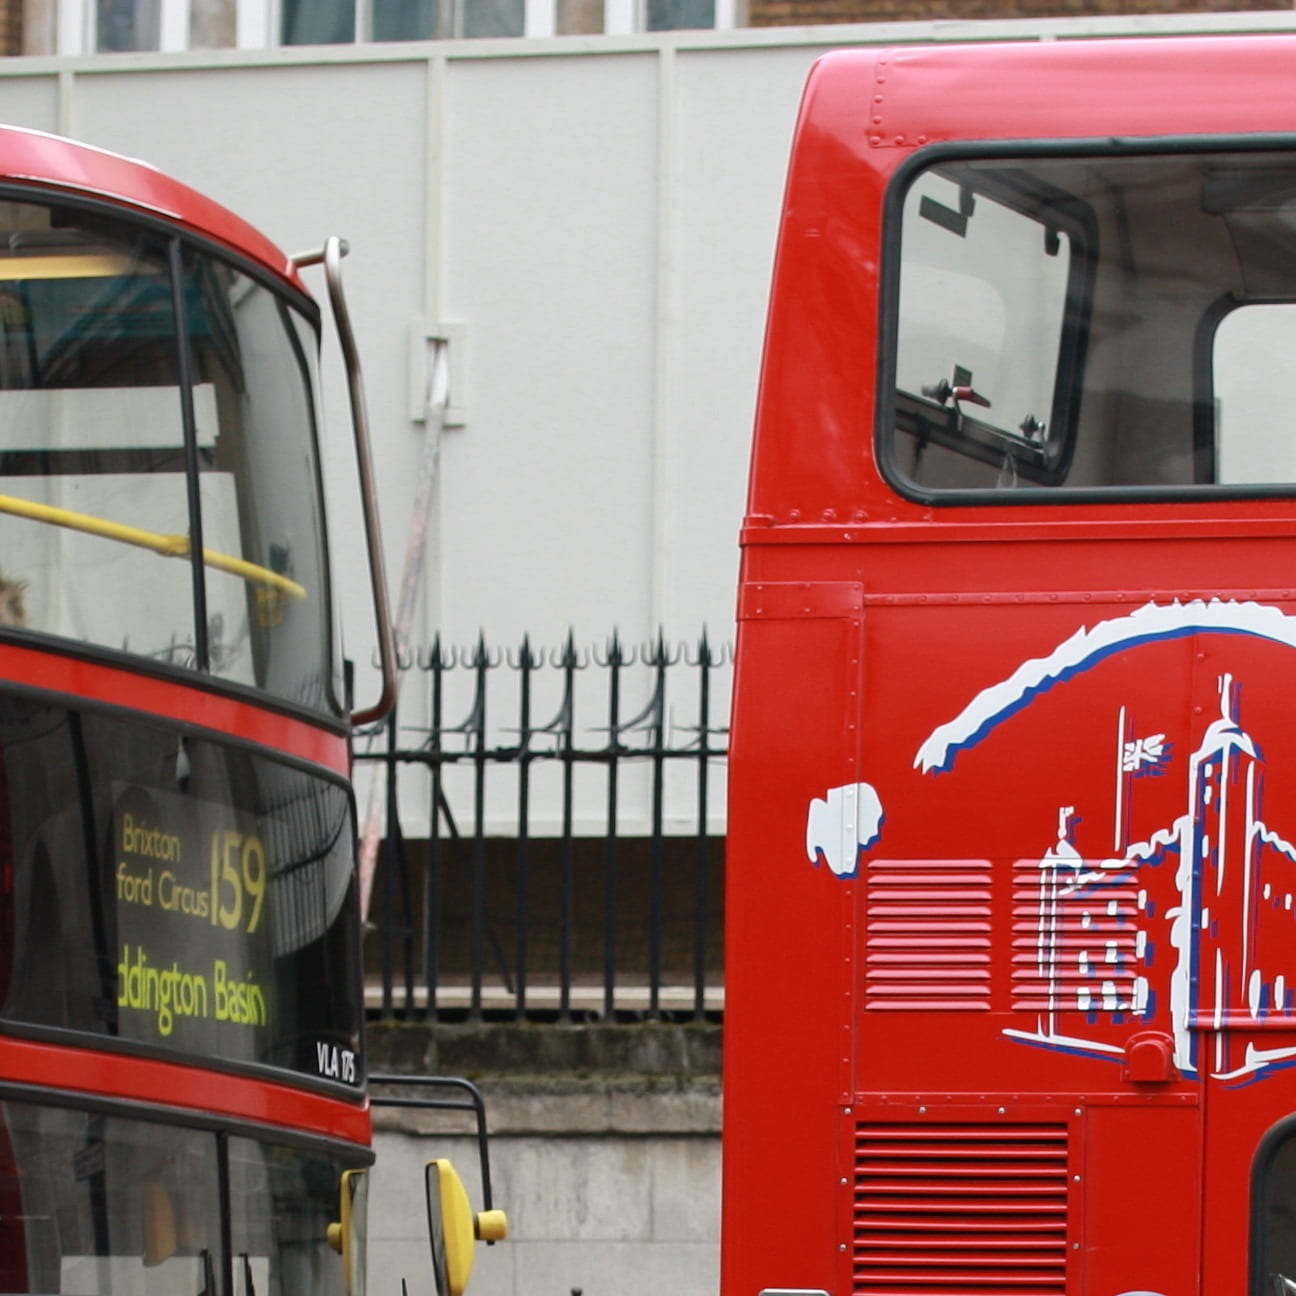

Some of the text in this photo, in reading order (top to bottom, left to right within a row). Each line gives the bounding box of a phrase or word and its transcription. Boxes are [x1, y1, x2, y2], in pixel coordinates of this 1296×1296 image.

[122, 813, 181, 863] Brixton
[158, 870, 209, 919] Circus
[210, 830, 267, 934] 159
[214, 959, 267, 1027] Basin
[316, 1041, 355, 1083] VLA 175
